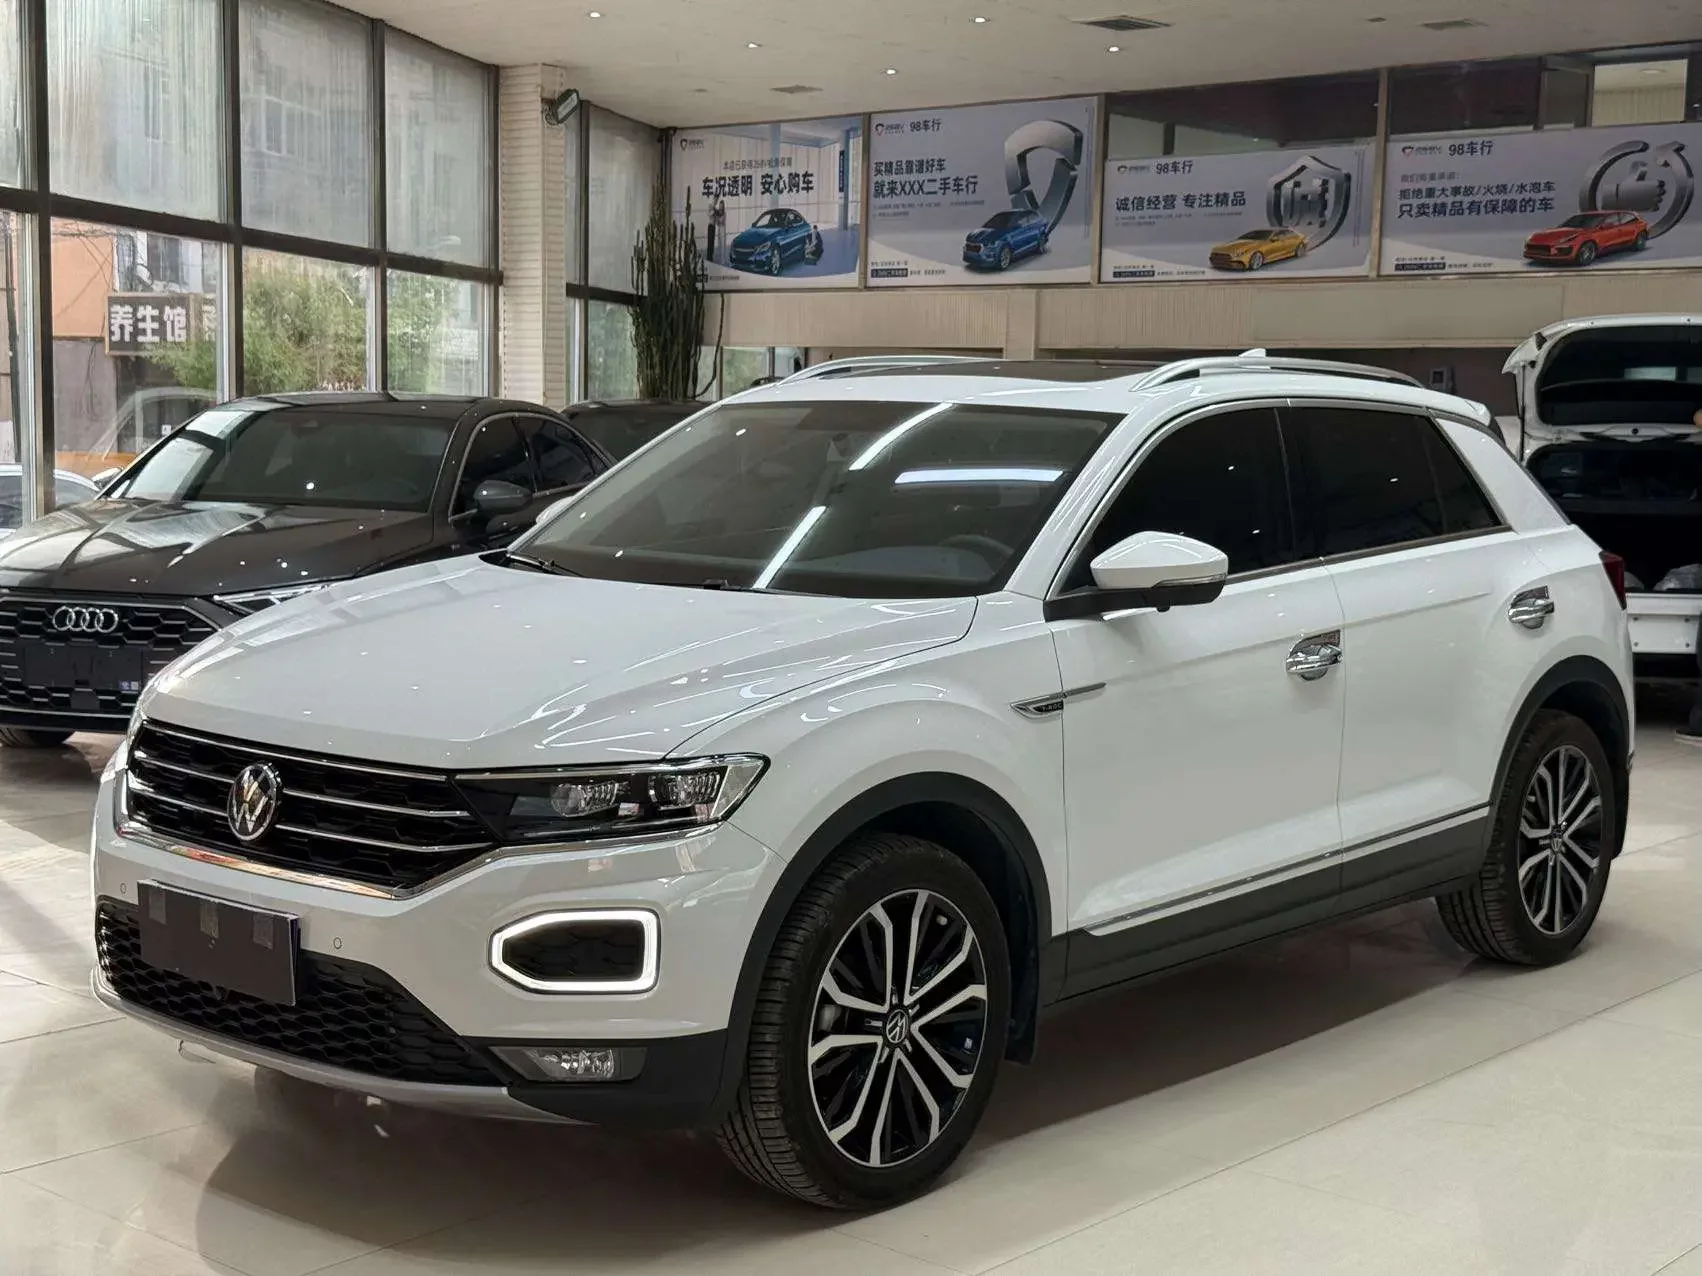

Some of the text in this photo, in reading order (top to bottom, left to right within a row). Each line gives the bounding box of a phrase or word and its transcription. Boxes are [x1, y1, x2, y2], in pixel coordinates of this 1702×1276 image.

[909, 119, 942, 132] 98车行
[1448, 140, 1494, 157] 98车行
[1155, 160, 1193, 175] 98车行
[701, 174, 753, 199] 车况透明
[760, 171, 815, 197] 安心购车
[873, 175, 978, 199] 就来XXX二手车行
[1115, 190, 1247, 212] 诚信经营 专注精品
[1397, 196, 1554, 219] 只卖精品有保障的车
[110, 304, 187, 343] 养生馆
